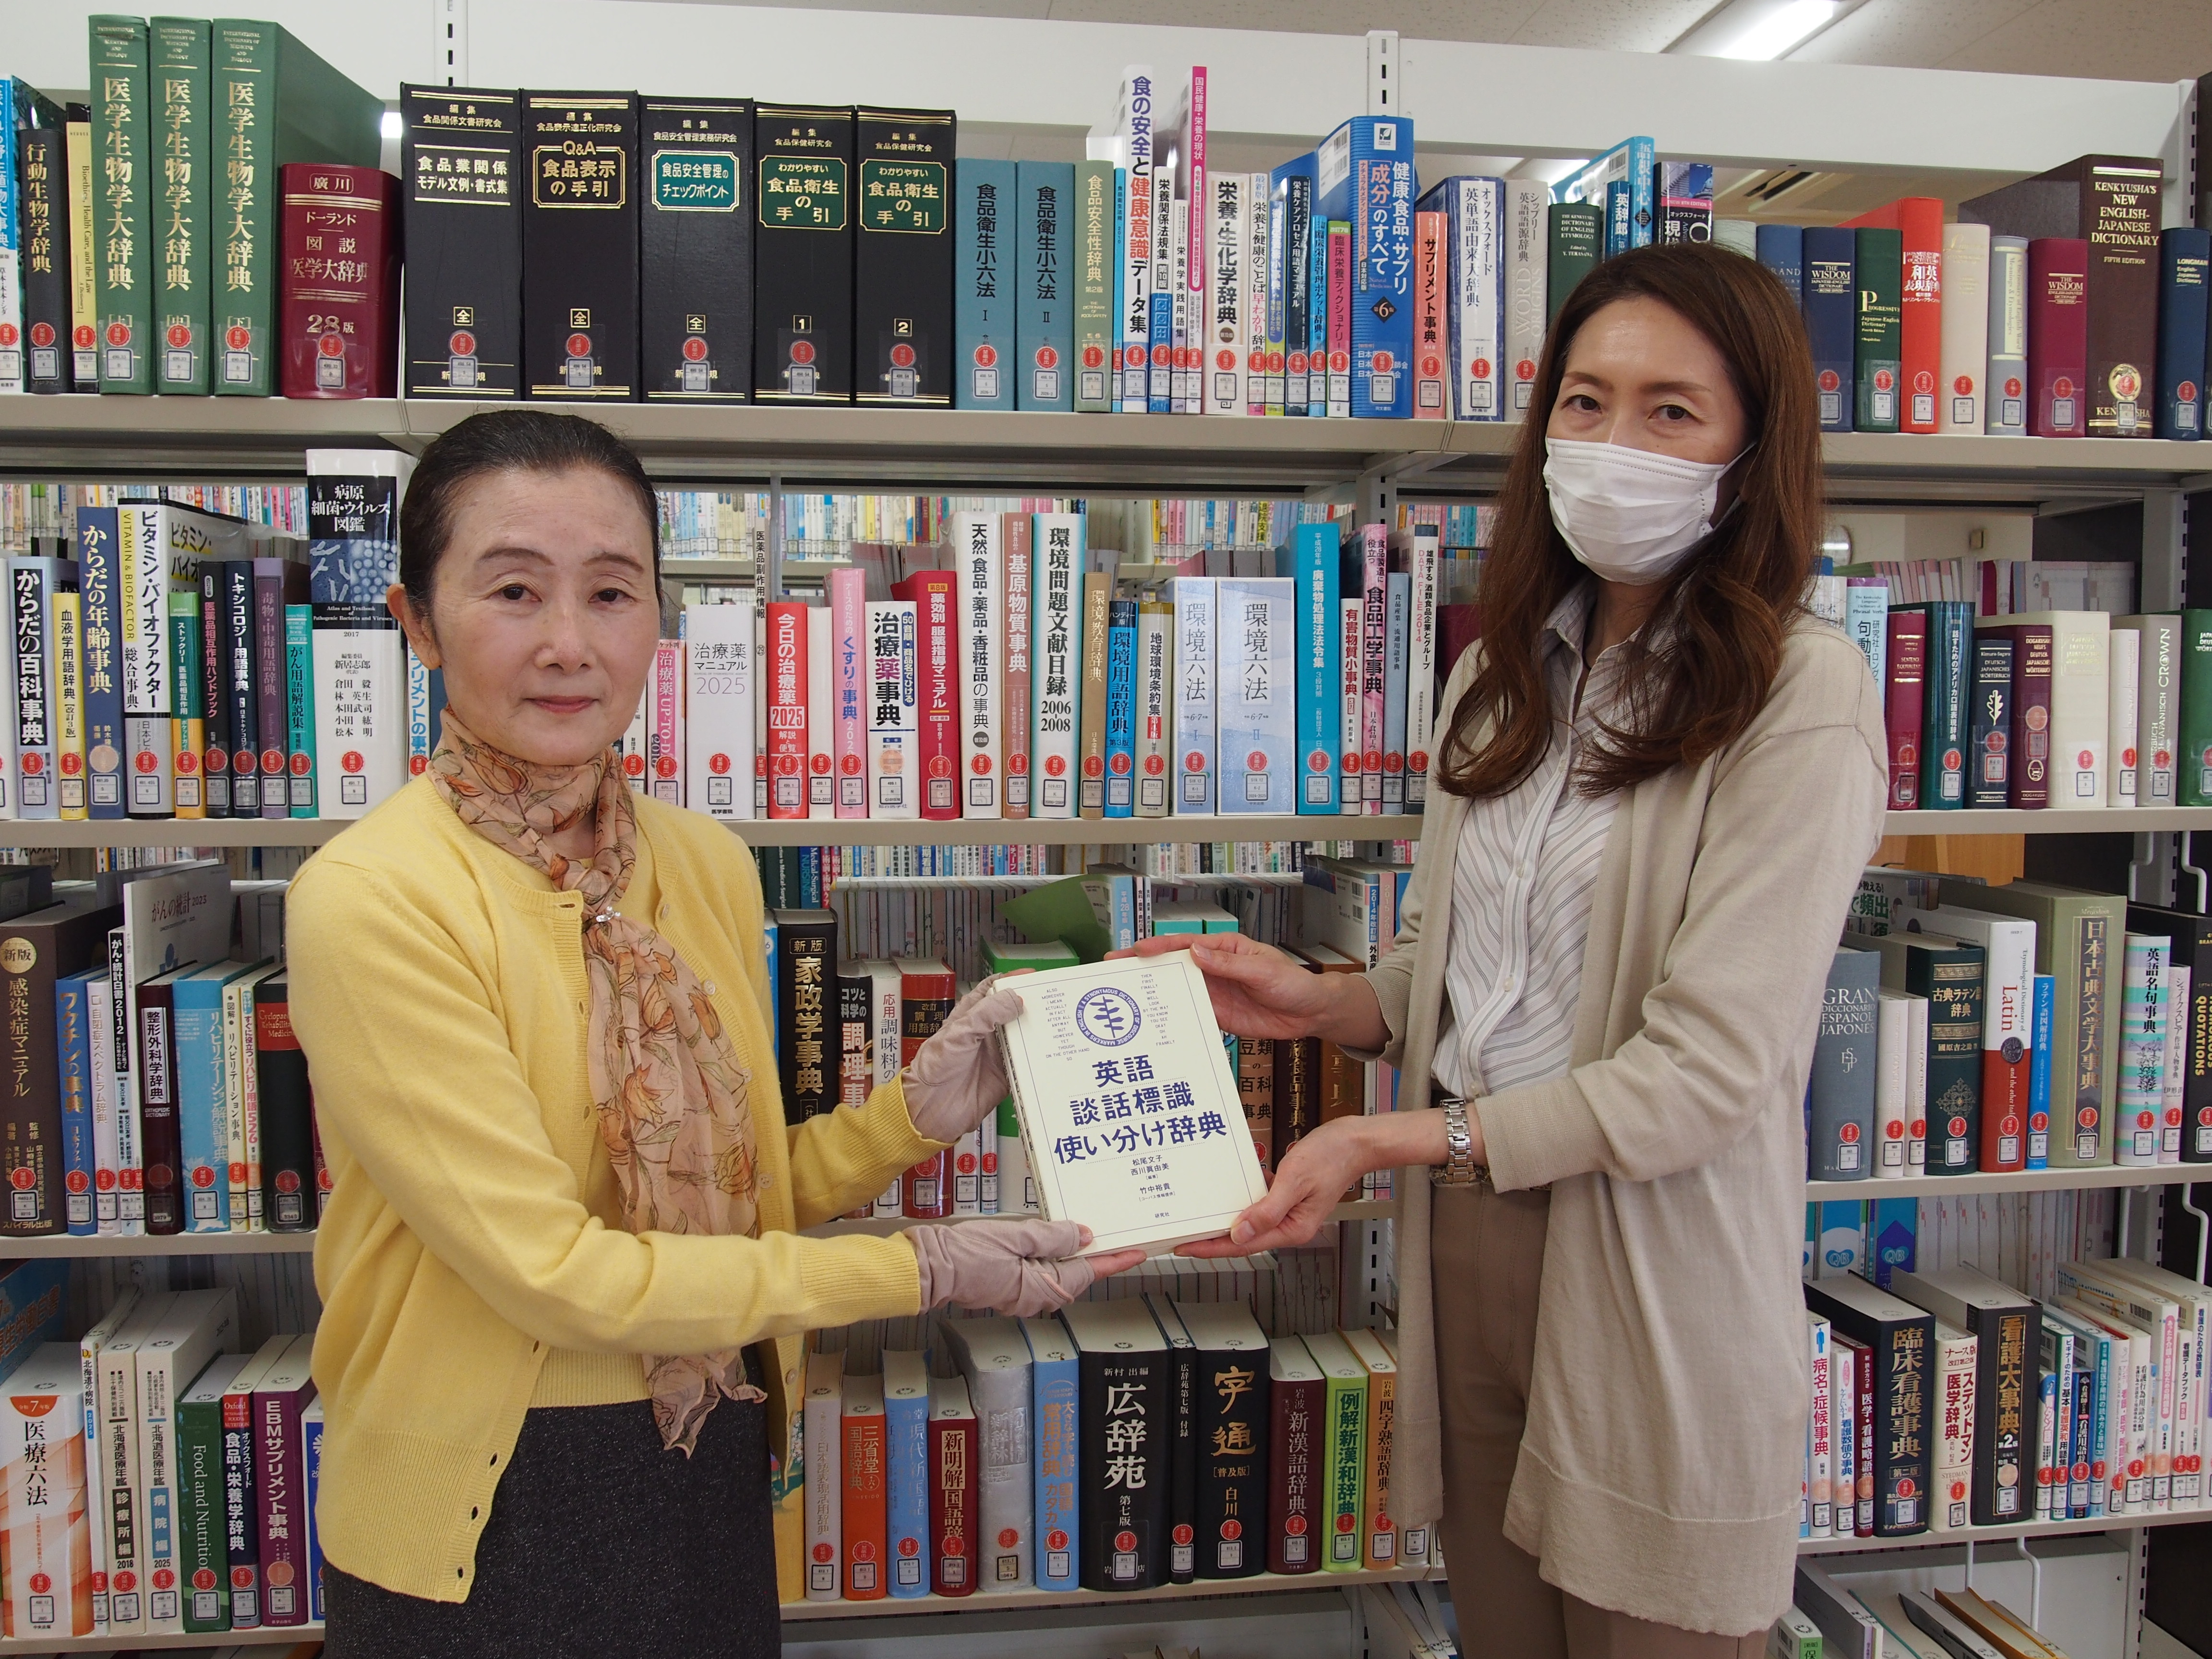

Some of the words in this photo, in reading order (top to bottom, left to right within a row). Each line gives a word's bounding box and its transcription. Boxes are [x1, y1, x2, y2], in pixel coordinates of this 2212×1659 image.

[423, 115, 502, 128] 食品関係文書研究会
[563, 141, 596, 156] Q&A
[1194, 76, 1204, 160] 国民健康・栄養の現状
[104, 78, 133, 290] 医学生物学大辞典
[164, 79, 192, 291] 医学生物学大辞典
[227, 81, 254, 292] 医学生物学大辞典
[417, 156, 507, 175] 食品業関係
[417, 175, 507, 193] モデル文例・書式集
[542, 159, 615, 178] 食品表示
[662, 161, 729, 179] 食品安全管理の
[662, 182, 729, 199] チェックポイント
[767, 177, 840, 194] 食品衛生
[778, 163, 829, 172] わかりやすい
[867, 181, 939, 198] 食品衛生
[879, 167, 928, 177] わかりやすい
[2094, 181, 2157, 194] KENKYUSHA'S
[26, 143, 52, 275] 行動生物学辞典
[306, 213, 357, 225] ドーランド
[1087, 174, 1103, 281] 食品安全性辞典
[1130, 76, 1151, 334] 食の安全と健康意識データ集
[1157, 180, 1170, 261] 栄養関係法規集
[1392, 161, 1411, 295] 健康食品・サプリ
[1518, 192, 1529, 262] 英語語源辞典
[1531, 192, 1540, 240] シップリー
[1615, 193, 1628, 236] 英辞郎
[2098, 220, 2151, 233] JAPANESE
[2099, 207, 2150, 219] ENGLISH-
[2112, 194, 2138, 205] NEW
[976, 183, 996, 299] 食品衛生小六法
[1037, 186, 1057, 300] 食品衛生小六法
[1217, 182, 1238, 325] 栄養・生化学辞典
[1465, 188, 1480, 307] 英単語由来大辞典
[1481, 188, 1492, 275] オックスフォード
[2091, 232, 2159, 246] DICTIONARY
[1176, 247, 1186, 338] 栄養学実践用語集
[1334, 236, 1344, 350] 臨床栄養ディクショナリー
[1424, 238, 1438, 343] サプリメント事典
[1811, 270, 1850, 279] WISDOM
[1911, 264, 1936, 280] 和英
[2048, 282, 2083, 291] WISDOM
[898, 322, 908, 333] 2
[334, 485, 364, 499] 病原
[123, 513, 132, 562] VITAMIN
[334, 517, 365, 532] 図鑑
[756, 530, 765, 619] 医薬品副作用情報
[83, 525, 113, 693] からだの年齢事典
[125, 574, 134, 639] BIOFACTOR
[141, 510, 161, 709] ビタミン・バイオファクター
[234, 573, 249, 692] トキシコロジー用語事典
[1009, 554, 1027, 673] 基原物質事典
[1046, 528, 1070, 696] 環境問題文献目録
[16, 571, 44, 744] からだの百科事典
[694, 643, 747, 659] 治療薬
[694, 662, 747, 671] マニュアル
[778, 613, 796, 705] 今日の治療薬
[874, 612, 900, 726] 治療薬事典
[1185, 603, 1205, 701] 環境六法
[1244, 603, 1268, 702] 環境六法
[1345, 610, 1358, 696] 有害物質小事典
[1365, 588, 1383, 694] 食品工学事典
[125, 648, 139, 709] 総合事典
[659, 652, 673, 694] 治療薬
[697, 677, 745, 694] 2025
[1111, 632, 1130, 734] 環境用語辞典
[1149, 633, 1162, 716] 地球環境条約集
[1949, 631, 1960, 741] 話すためのアメリカ口語表現辞典
[336, 704, 372, 713] 本田武司
[773, 709, 803, 727] 2025
[802, 855, 810, 896] NURSING
[1084, 988, 1118, 1001] SYNONYMOUS
[1118, 992, 1139, 1015] DICTIONARY
[1822, 987, 1875, 1004] GRAN
[1822, 1004, 1875, 1013] DICCIONARIO
[2002, 984, 2018, 1032] Latin
[2080, 920, 2104, 1090] 日本古典文学大事典
[2143, 948, 2159, 1033] 英語名句事典
[9, 978, 30, 1097] 感染症マニュアル
[146, 1012, 163, 1100] 整形外科学辞典
[795, 957, 824, 1094] 家政学事典
[1090, 1034, 1115, 1046] MARKERS
[1118, 1025, 1139, 1044] DISCOURSE
[2196, 996, 2207, 1076] QUOTATIONS
[1092, 1055, 1154, 1088] 英語
[1070, 1081, 1194, 1126] 談話標識
[1054, 1110, 1227, 1165] 使い分け辞典
[1132, 1155, 1163, 1166] 松尾文子
[225, 1402, 246, 1410] Oxford
[1813, 1358, 1828, 1456] 病名・症候事典
[1890, 1328, 1923, 1460] 臨床看護事典
[1998, 1318, 2024, 1434] 看護大事典
[1104, 1383, 1147, 1490] 広辞苑
[1211, 1366, 1256, 1457] 字通
[1946, 1375, 1960, 1440] 医学辞典
[1961, 1373, 1973, 1462] ステッドマン
[24, 1420, 48, 1506] 医療六法
[113, 1424, 127, 1486] 北海道医療年鑑
[152, 1424, 165, 1486] 北海道医療年鑑
[192, 1444, 205, 1479] Food
[265, 1401, 288, 1539] EBMサプリメント事典
[848, 1426, 862, 1490] 国語辞典
[863, 1426, 878, 1473] 三省堂
[944, 1432, 963, 1488] 新明解
[1287, 1412, 1309, 1515] 新漢語辞典
[194, 1481, 205, 1505] and
[226, 1432, 244, 1551] 食品・栄養学辞典
[1119, 1495, 1131, 1527] 第七版
[116, 1493, 131, 1556] 診療所編
[154, 1494, 168, 1552] 病院編
[117, 1559, 133, 1568] 2018
[154, 1559, 170, 1567] 2025
